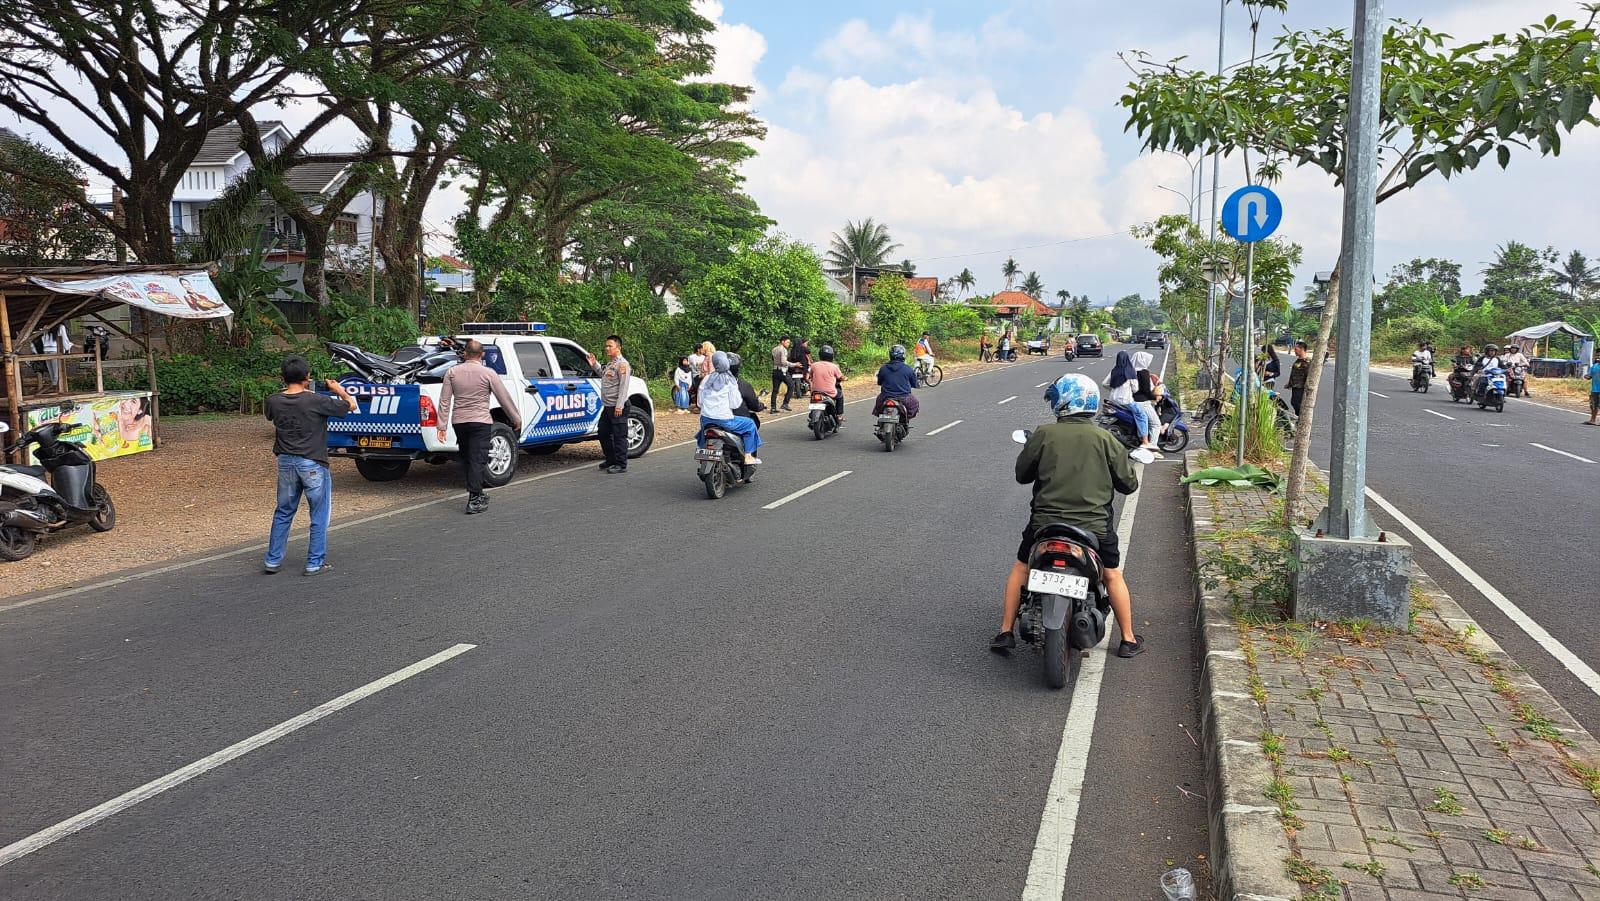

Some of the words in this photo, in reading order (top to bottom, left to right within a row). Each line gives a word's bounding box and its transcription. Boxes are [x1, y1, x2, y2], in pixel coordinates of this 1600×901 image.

[546, 393, 586, 412] POLISI
[546, 412, 563, 421] LALU
[564, 411, 586, 419] LINTAS
[1031, 570, 1037, 580] Z
[1042, 573, 1065, 583] 5732
[1075, 578, 1087, 588] KJ
